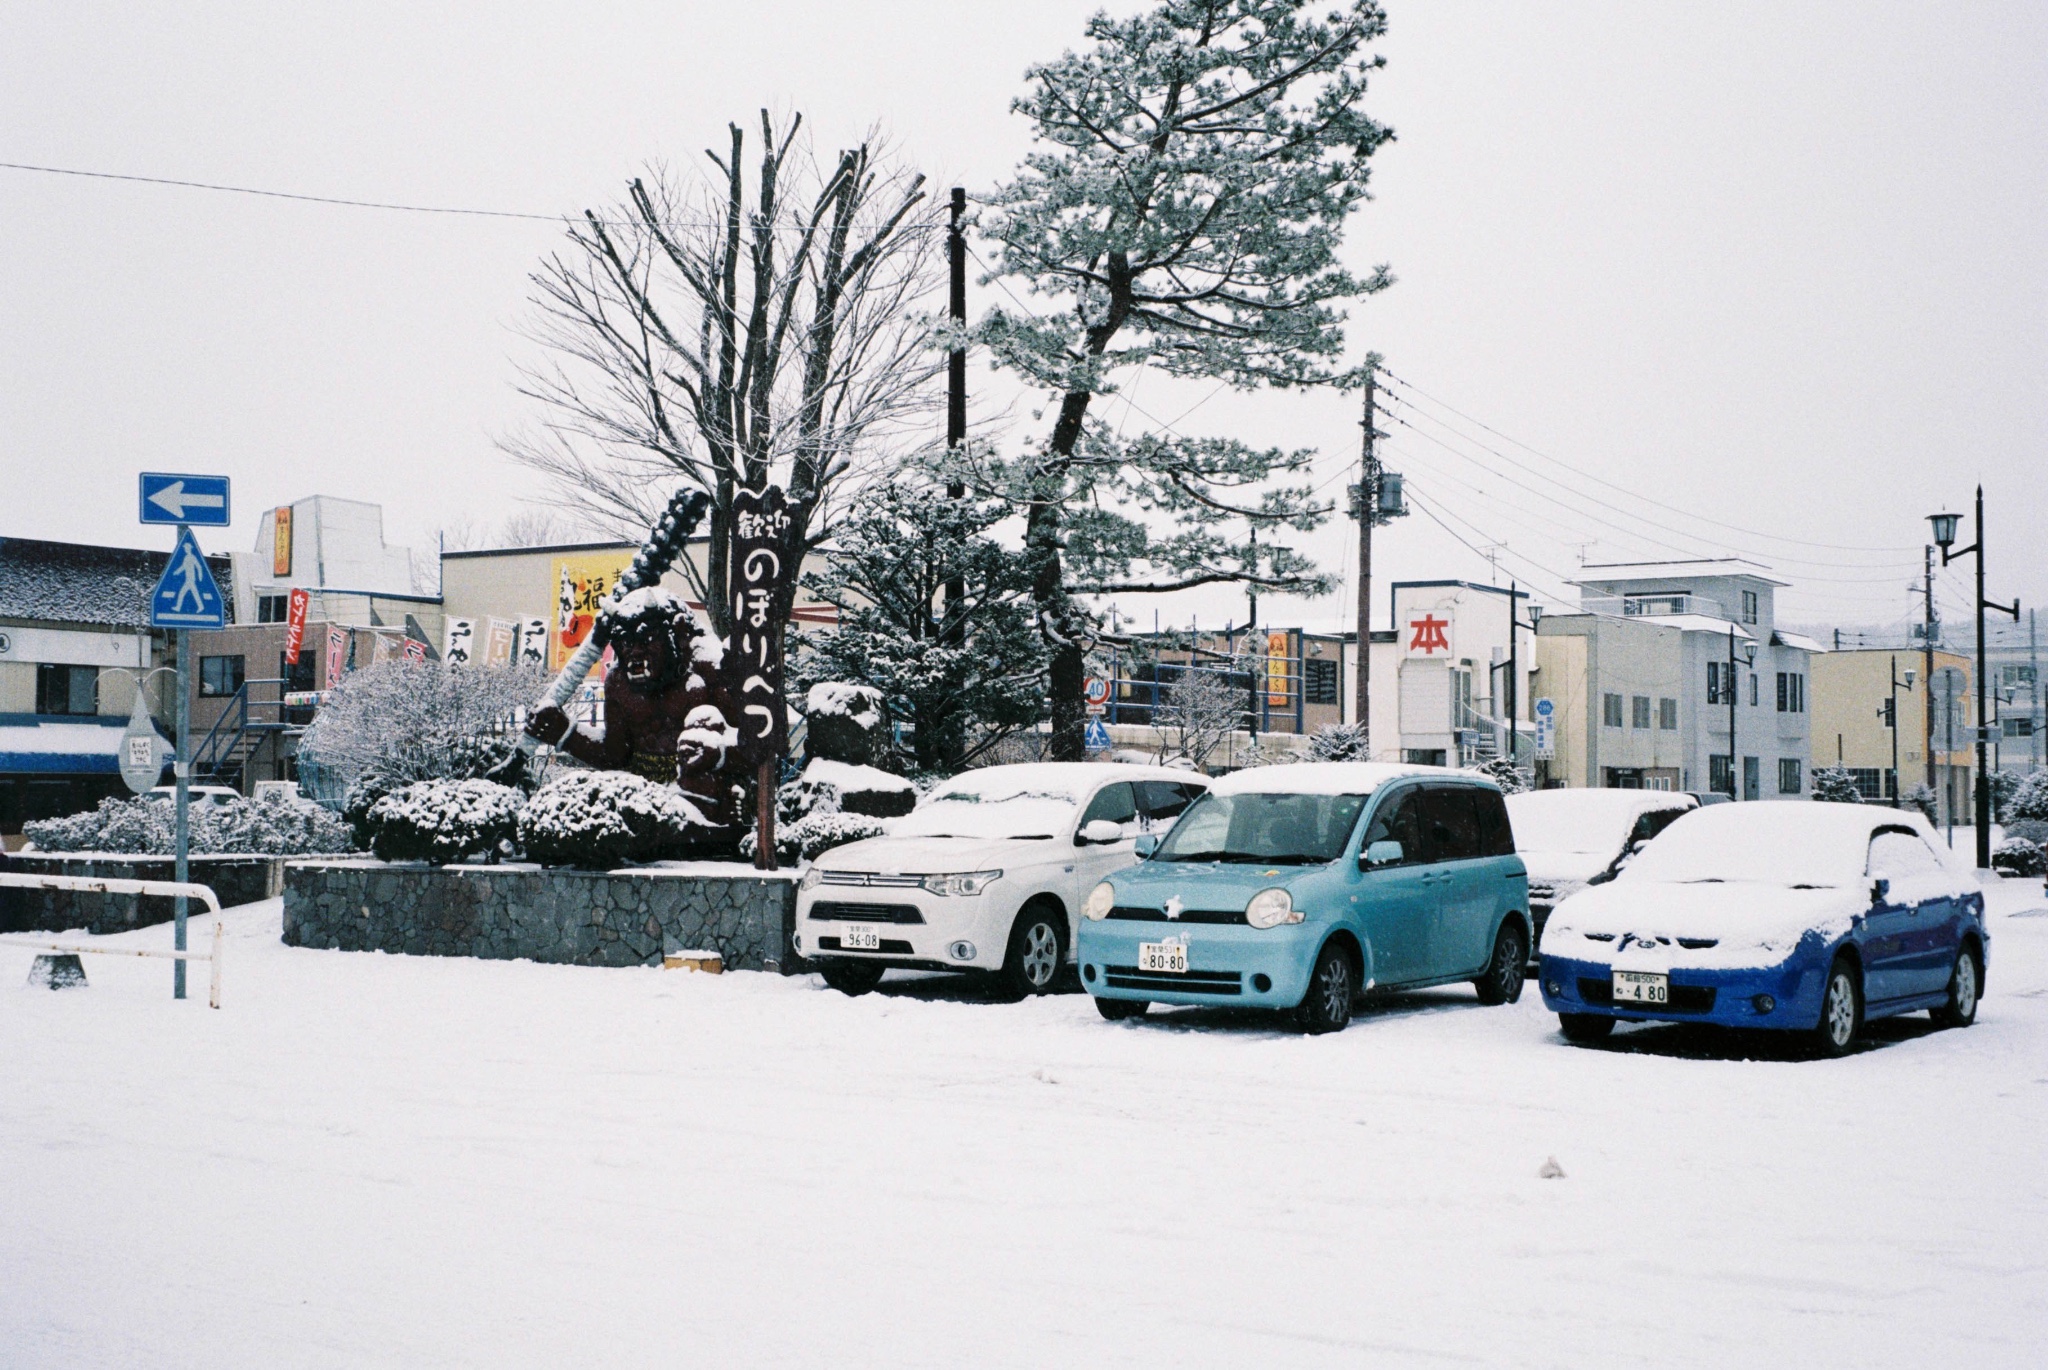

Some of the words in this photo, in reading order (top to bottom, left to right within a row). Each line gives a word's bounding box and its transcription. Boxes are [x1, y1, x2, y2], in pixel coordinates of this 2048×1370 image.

[738, 509, 791, 539] 歓迎
[736, 548, 780, 738] のぼりべつ
[1410, 614, 1449, 654] 本
[1089, 682, 1104, 696] 40
[1150, 955, 1184, 970] 80-80
